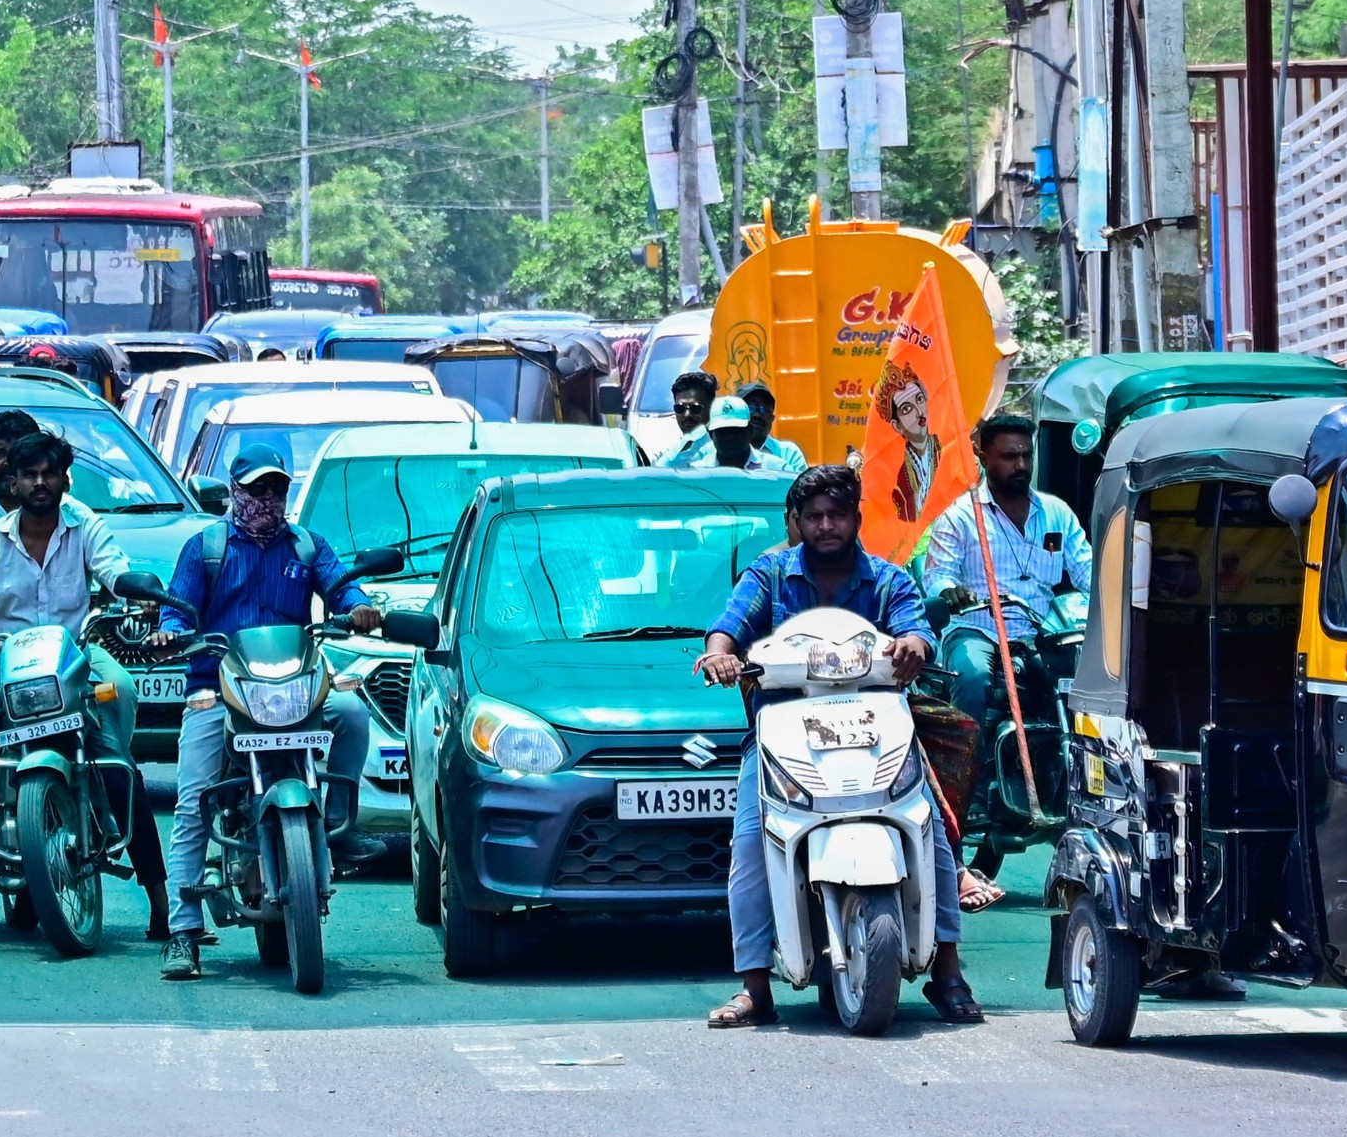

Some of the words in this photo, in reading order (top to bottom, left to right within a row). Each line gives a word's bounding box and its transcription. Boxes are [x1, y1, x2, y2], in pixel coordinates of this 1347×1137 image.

[833, 379, 863, 399] Jai
[27, 725, 47, 738] 32R
[52, 716, 81, 733] 0329
[236, 738, 264, 749] KA32
[275, 737, 291, 747] EZ
[303, 734, 330, 746] 4959
[619, 797, 632, 805] IND
[637, 788, 737, 815] KA39M33
